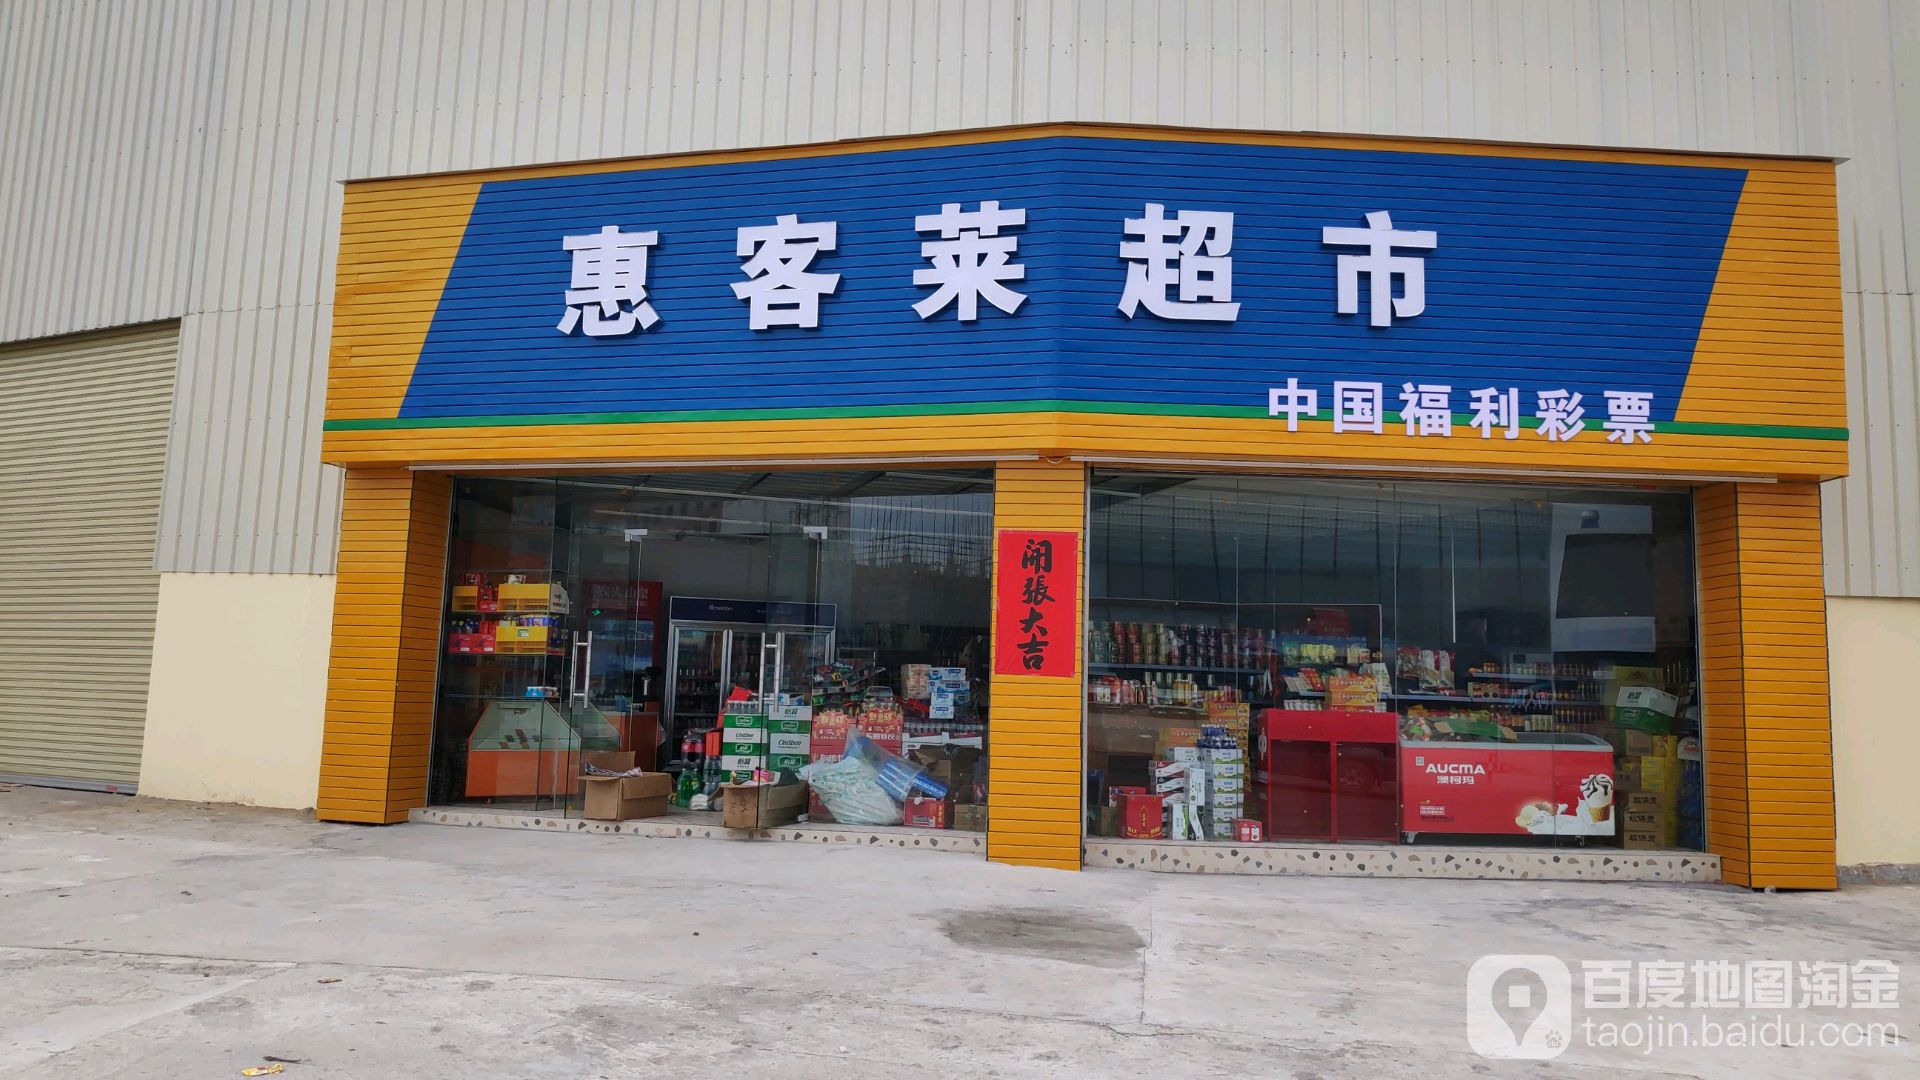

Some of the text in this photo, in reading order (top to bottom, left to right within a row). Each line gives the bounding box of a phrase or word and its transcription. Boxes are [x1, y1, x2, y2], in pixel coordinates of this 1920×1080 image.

[556, 200, 1437, 337] 惠客莱超市
[1268, 377, 1655, 444] 中国福利彩票
[1425, 763, 1486, 774] AUCMA
[1436, 775, 1475, 785] 澳柯玛
